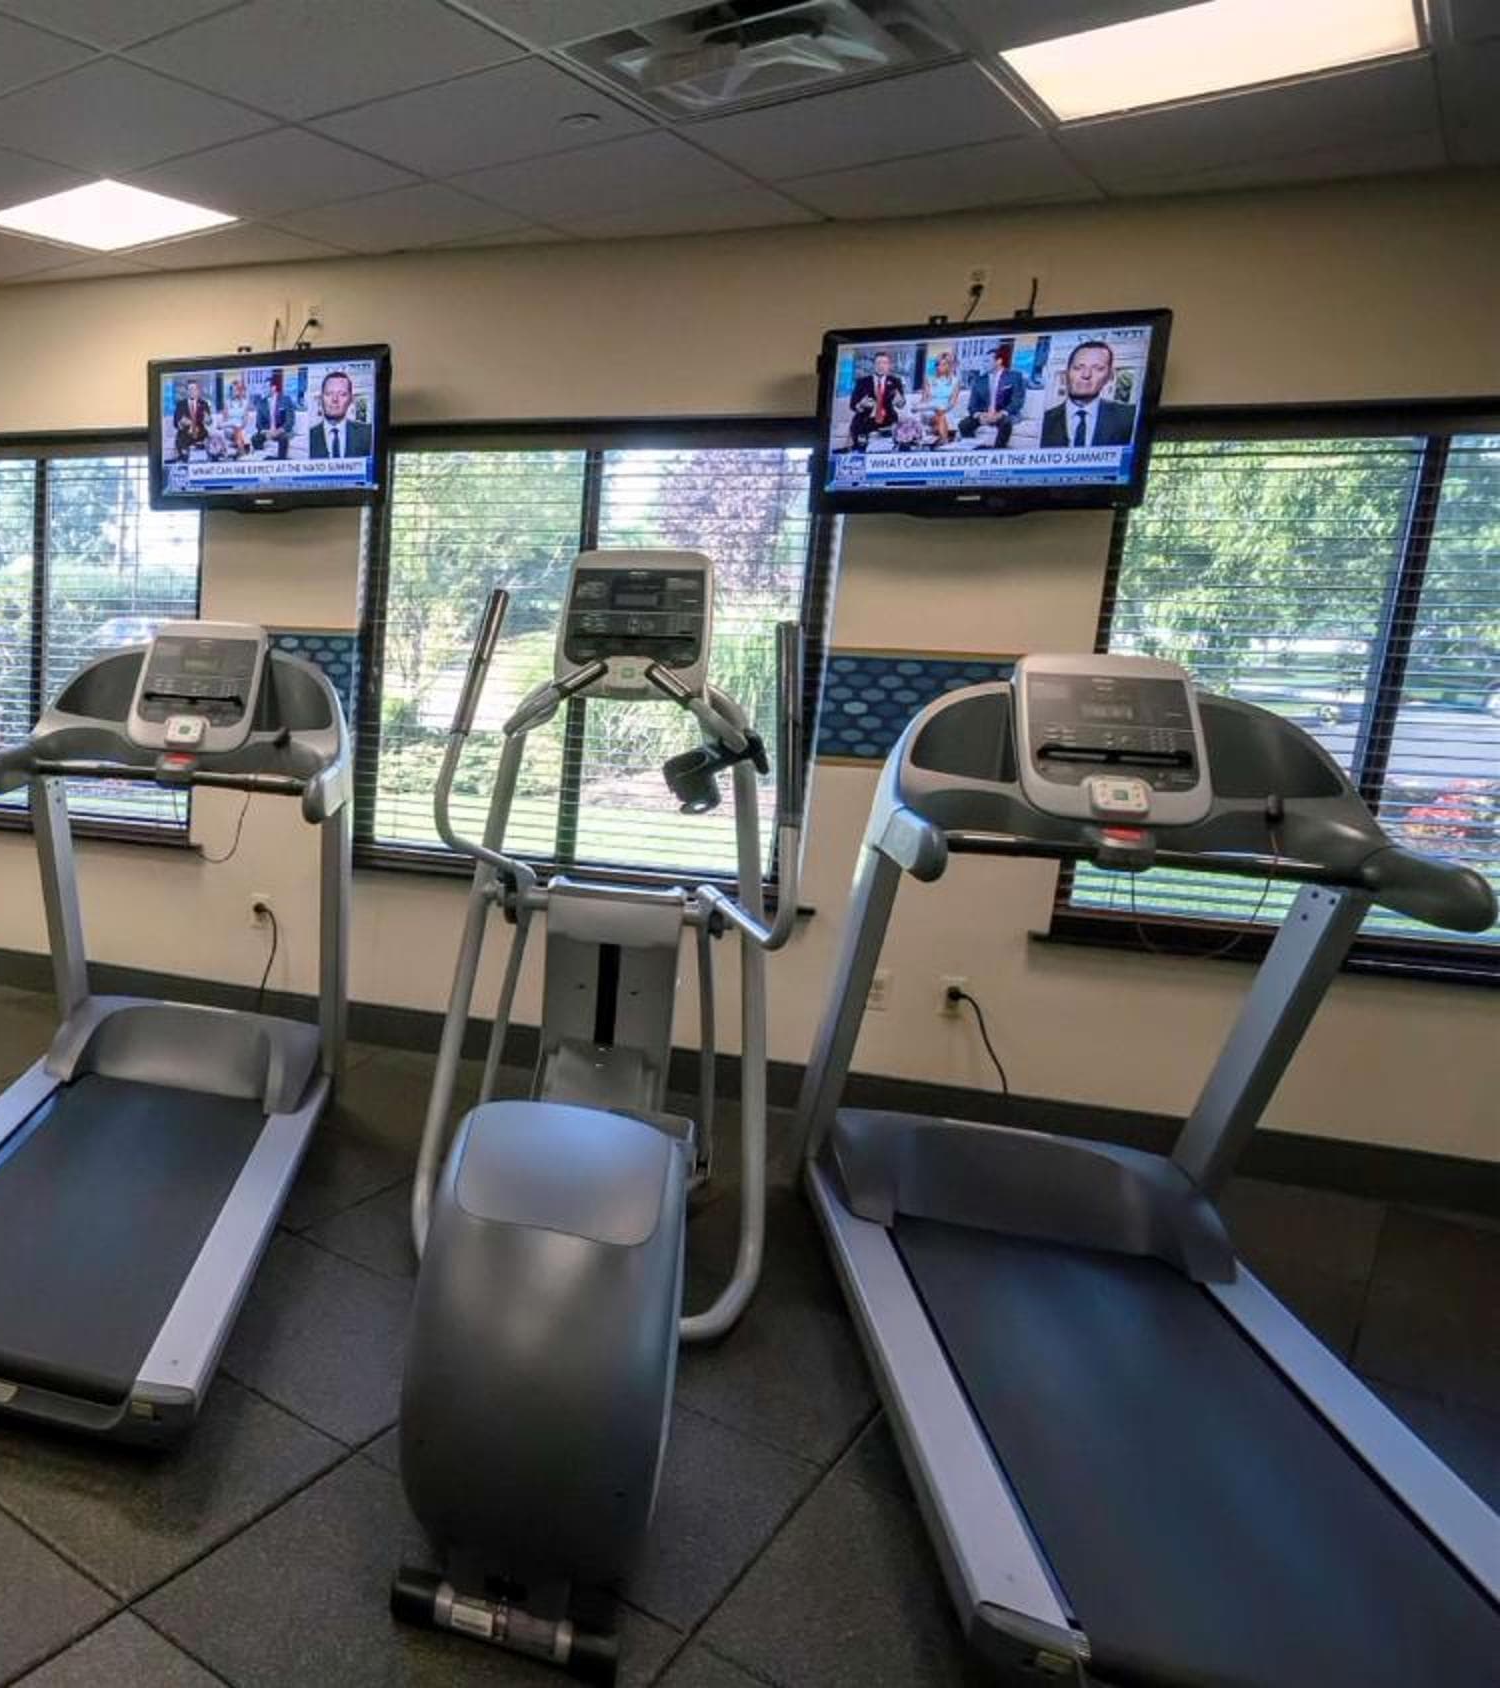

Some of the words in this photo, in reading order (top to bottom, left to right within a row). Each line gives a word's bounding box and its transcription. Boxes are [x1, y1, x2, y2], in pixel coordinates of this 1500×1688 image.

[870, 457, 901, 469] WHAT
[903, 457, 928, 469] CAN
[930, 456, 946, 468] WE
[950, 455, 988, 467] EXPECT
[991, 454, 1004, 465] AT
[1007, 453, 1026, 465] THE
[1029, 452, 1063, 464] NATO
